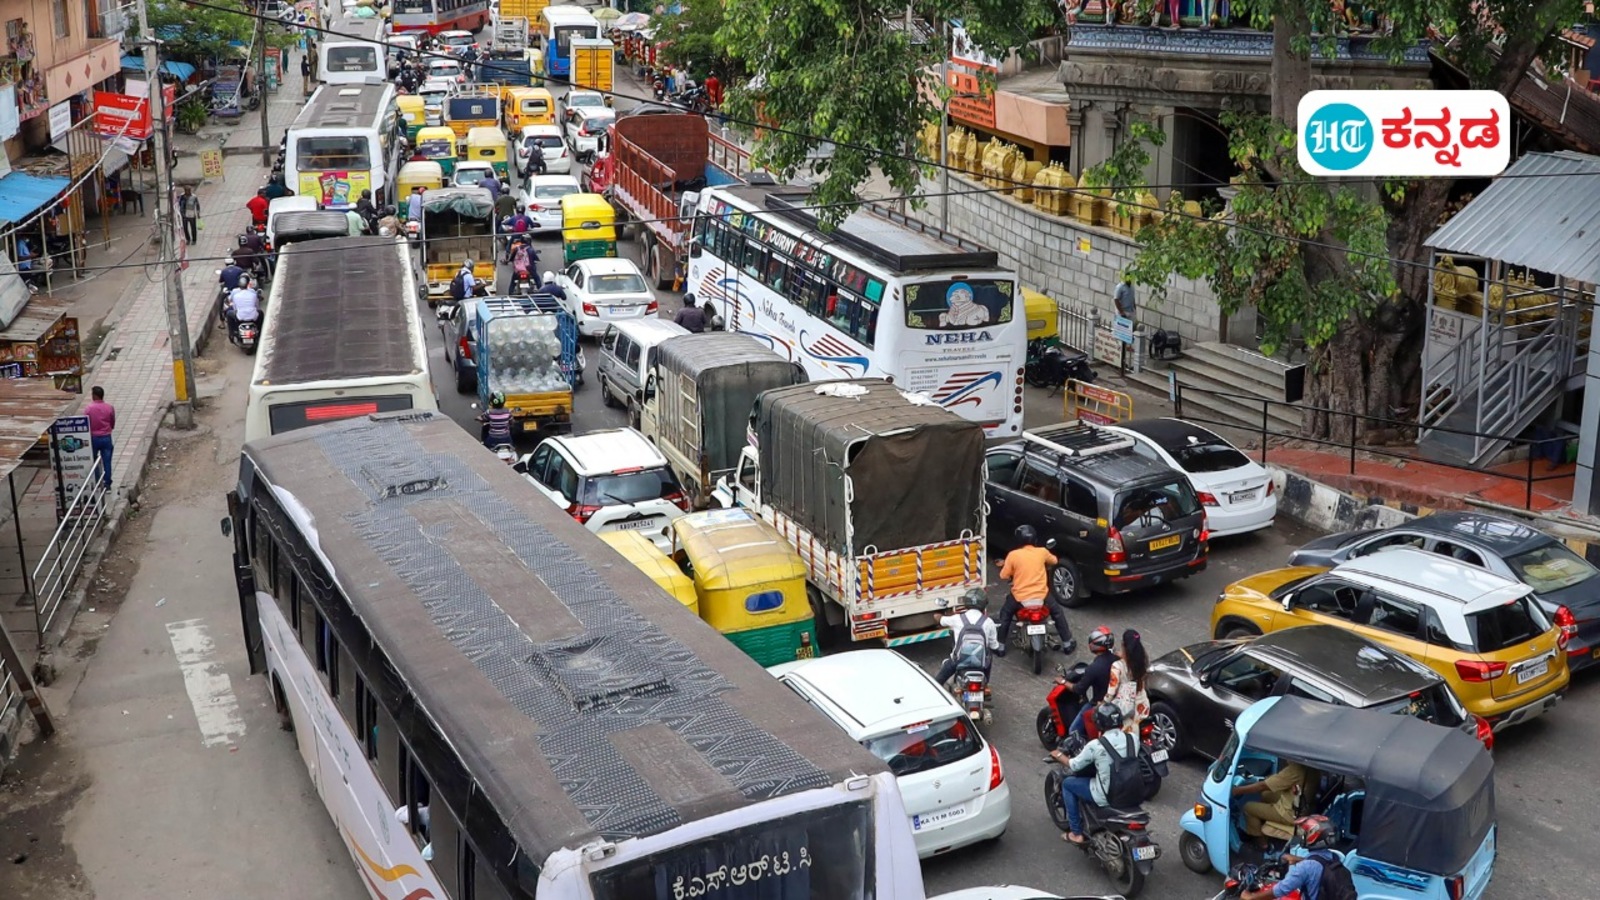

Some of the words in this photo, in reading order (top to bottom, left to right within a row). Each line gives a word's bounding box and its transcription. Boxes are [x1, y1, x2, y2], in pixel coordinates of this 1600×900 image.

[764, 226, 797, 255] JOURNY
[924, 331, 993, 346] NEHA
[858, 630, 882, 639] STOP
